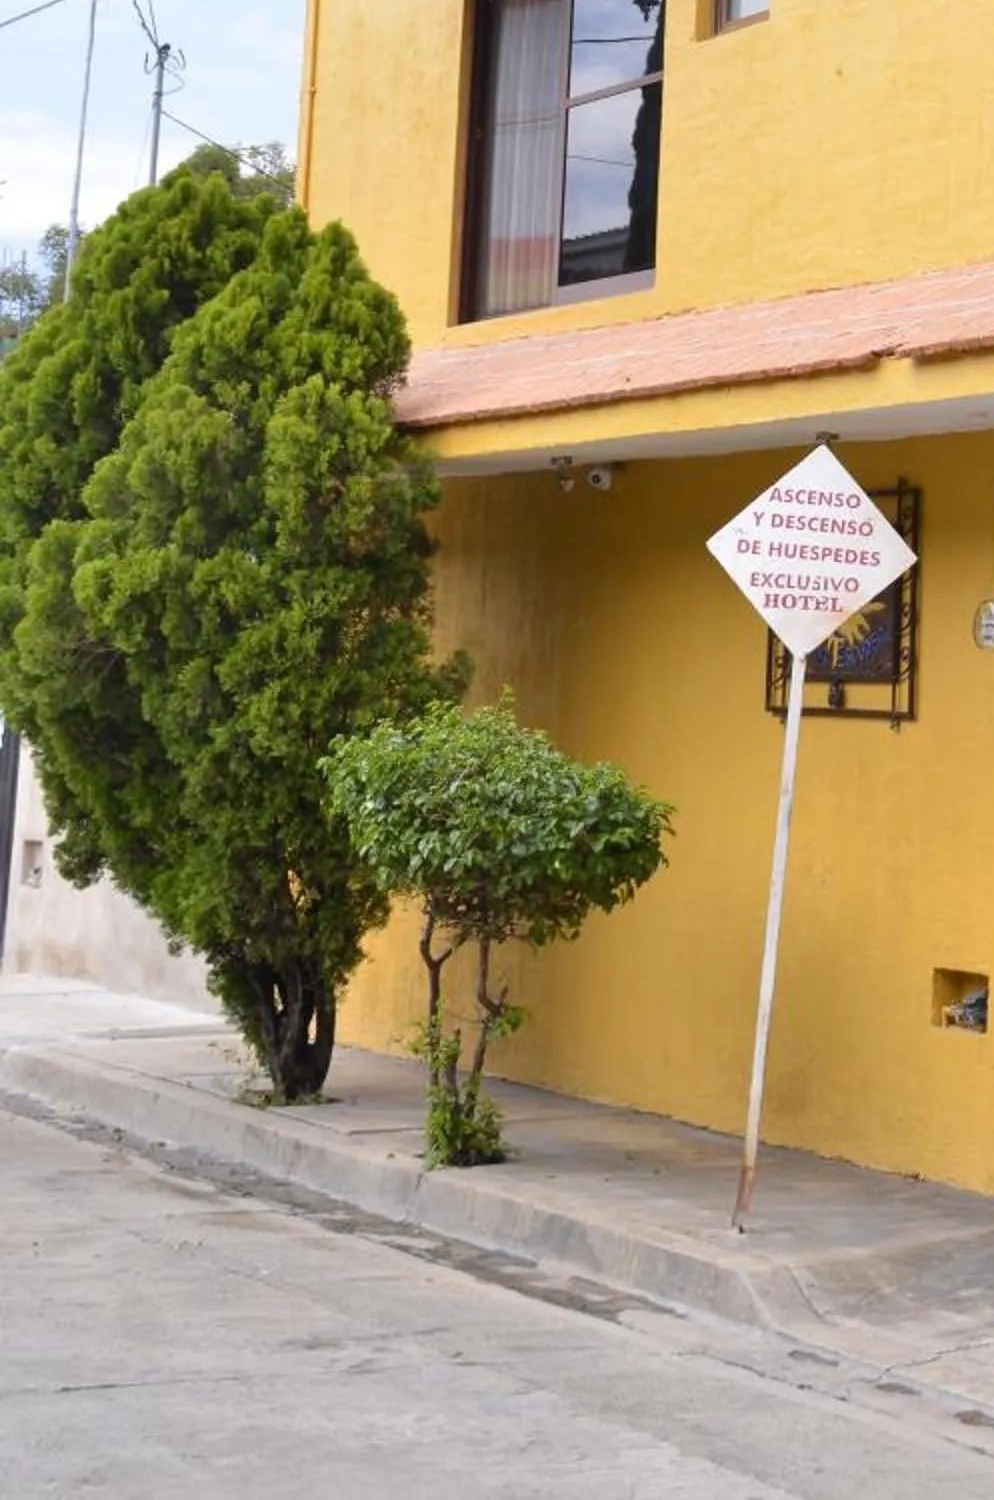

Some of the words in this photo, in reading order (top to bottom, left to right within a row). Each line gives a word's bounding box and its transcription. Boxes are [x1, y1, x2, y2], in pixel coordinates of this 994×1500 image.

[768, 487, 861, 509] ASCENSO
[753, 511, 765, 527] Y
[771, 513, 874, 537] DESCENSO
[736, 539, 762, 555] DE
[767, 541, 881, 567] HUESPEDES
[750, 572, 860, 593] EXCLUSIVO
[762, 593, 844, 613] HOTEL
